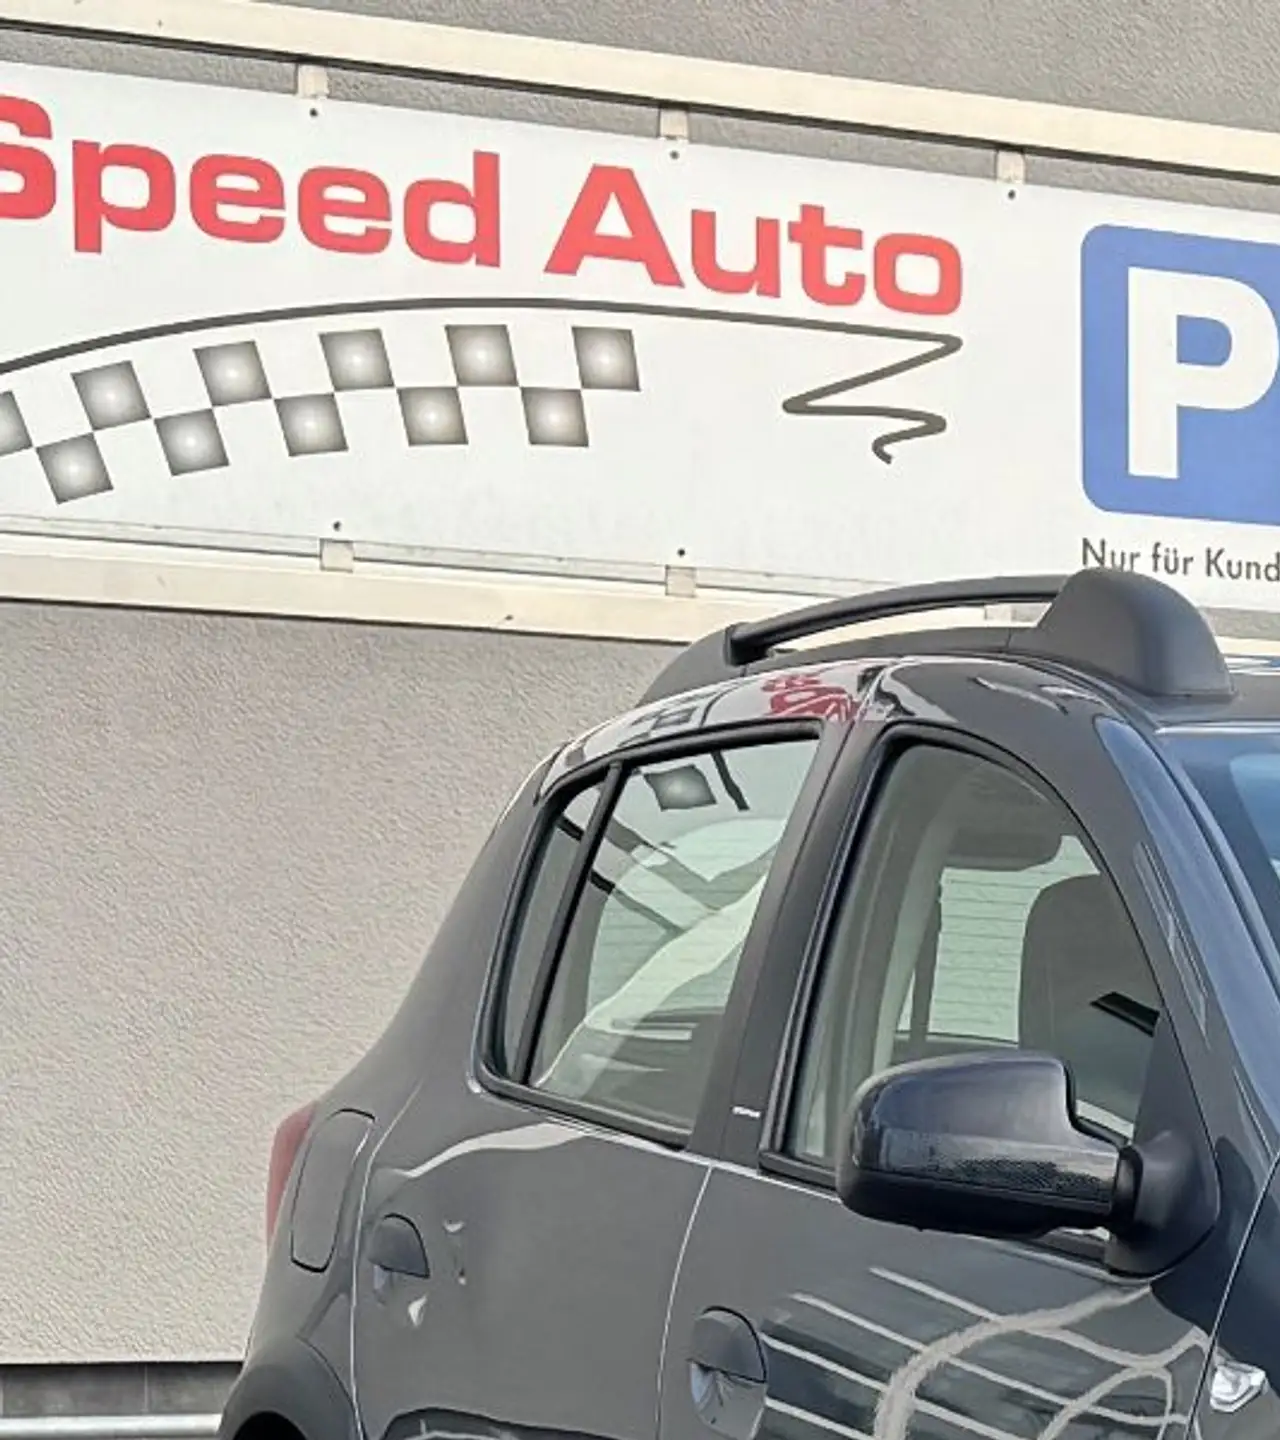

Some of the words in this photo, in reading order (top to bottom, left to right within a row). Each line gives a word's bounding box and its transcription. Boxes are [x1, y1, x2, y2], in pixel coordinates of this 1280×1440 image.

[544, 164, 964, 316] Auto
[1127, 266, 1280, 481] P
[1081, 537, 1140, 572] Nur
[1151, 542, 1194, 576] für
